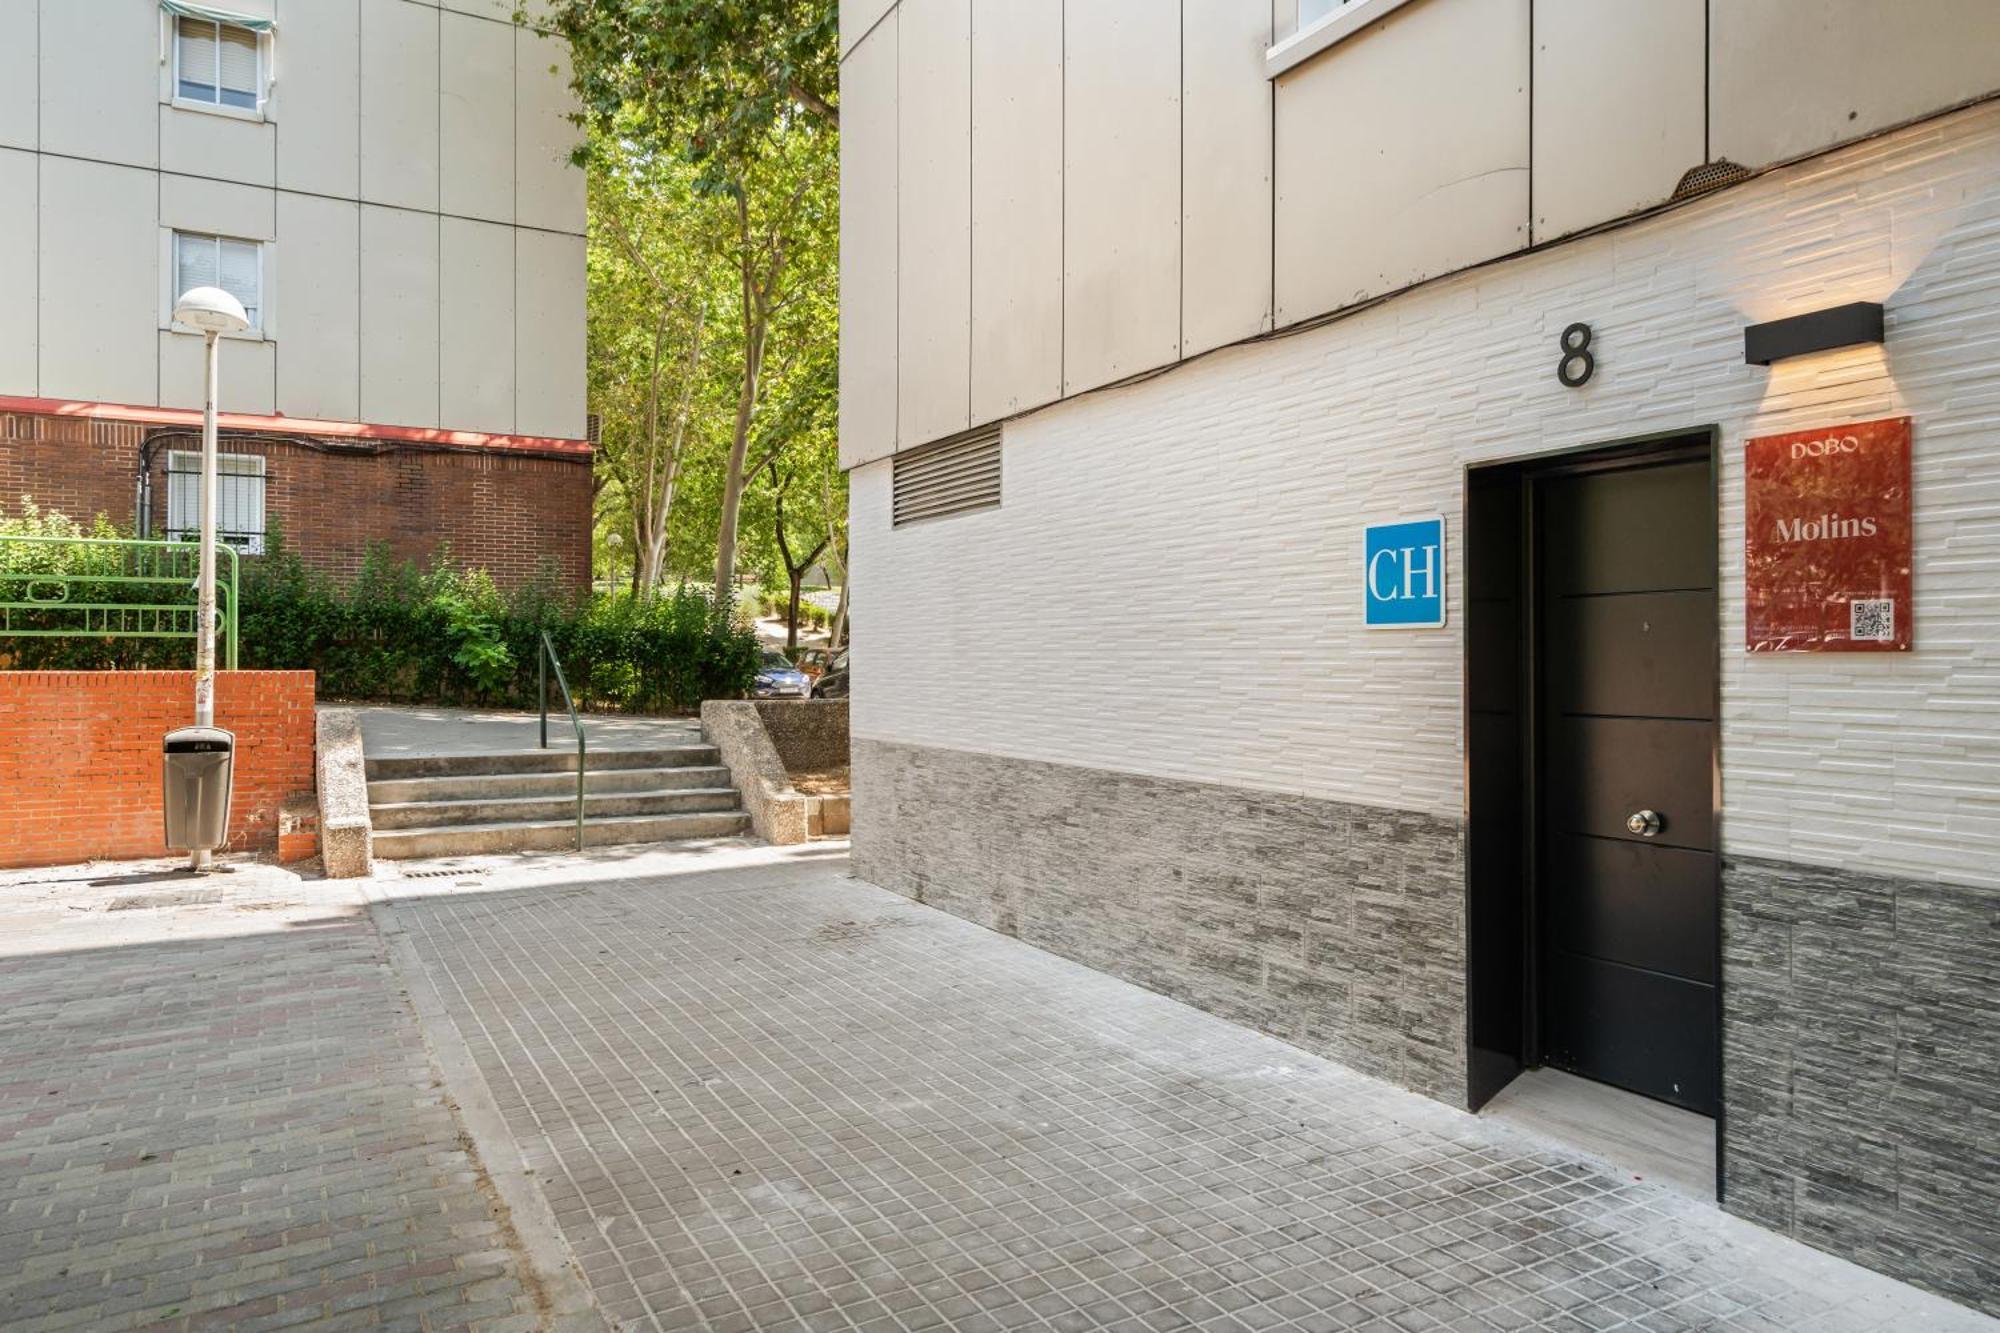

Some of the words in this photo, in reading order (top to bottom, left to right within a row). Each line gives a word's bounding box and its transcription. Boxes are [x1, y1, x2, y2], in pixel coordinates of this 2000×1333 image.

[1557, 322, 1594, 387] 8
[1791, 436, 1859, 460] DOBO
[1775, 513, 1878, 544] Molins
[1368, 544, 1438, 601] CH
